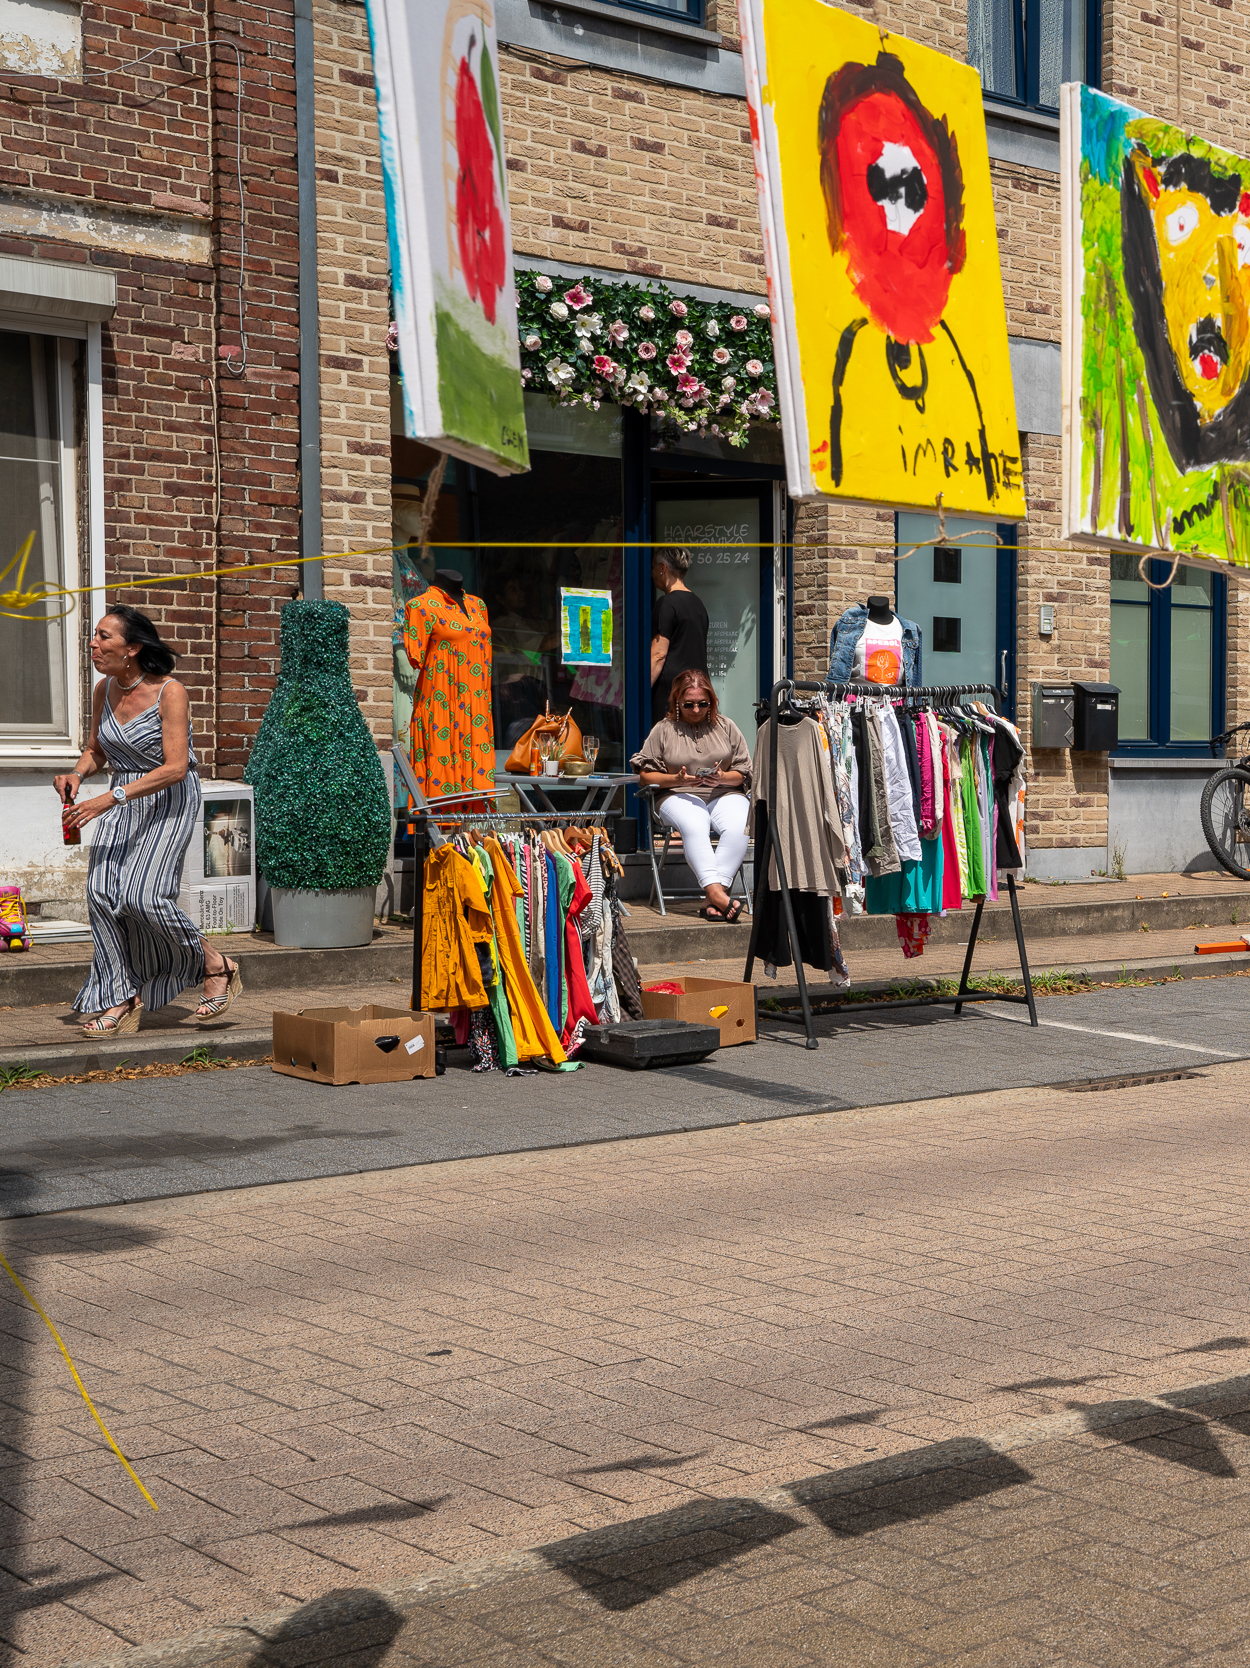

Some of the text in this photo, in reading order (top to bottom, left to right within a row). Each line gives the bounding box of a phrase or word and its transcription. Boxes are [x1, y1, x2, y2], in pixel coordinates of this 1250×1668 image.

[664, 524, 749, 537] HAARSTYLE
[697, 552, 712, 564] 56
[716, 552, 731, 564] 25
[733, 551, 750, 564] 24
[866, 639, 900, 647] APEROL
[205, 921, 211, 929] GL
